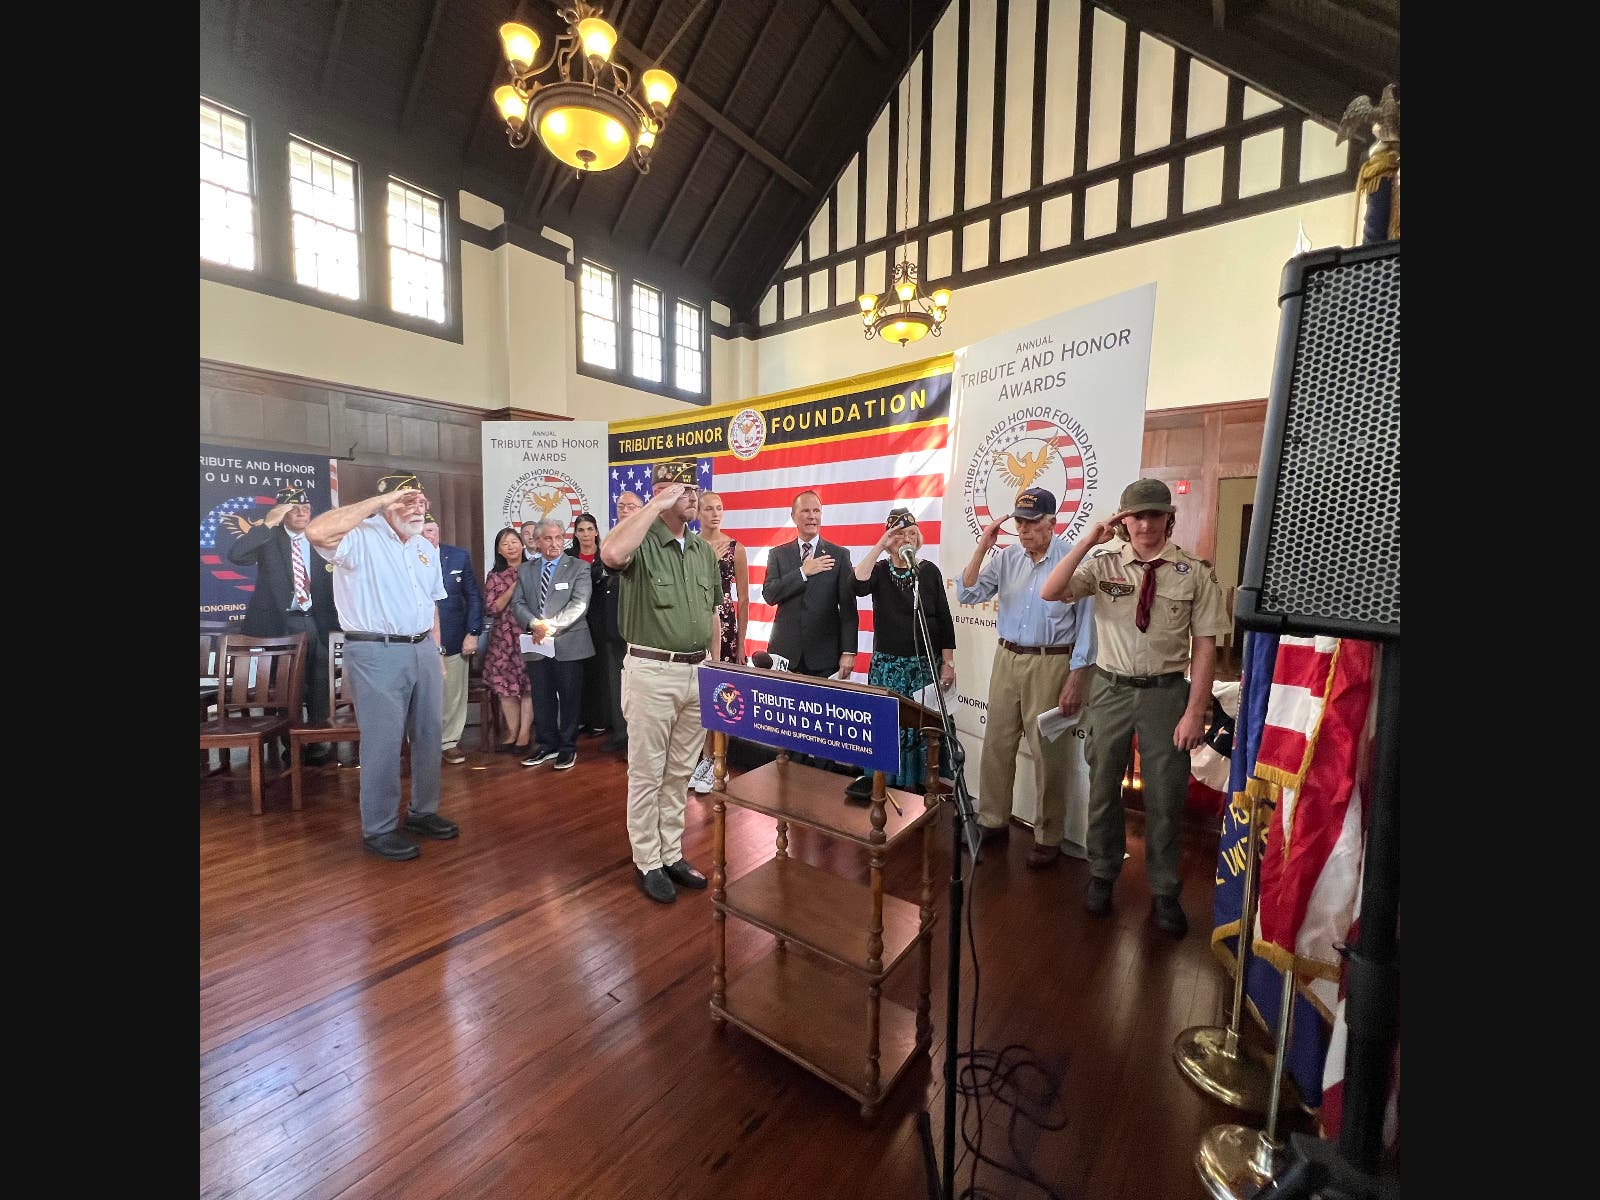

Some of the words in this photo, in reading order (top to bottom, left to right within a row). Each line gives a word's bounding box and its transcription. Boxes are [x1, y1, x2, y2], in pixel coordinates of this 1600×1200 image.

[961, 361, 1016, 390] TRIBUTE
[1021, 350, 1054, 373] AND
[1060, 328, 1131, 361] HONOR
[1016, 334, 1054, 354] ANNUAL
[998, 372, 1067, 401] AWARDS
[771, 389, 927, 434] FOUNDATION
[490, 438, 534, 449] TRIBUTE
[537, 440, 558, 449] AND
[562, 438, 600, 449] HONOR
[618, 435, 664, 453] TRIBUTE
[665, 434, 674, 449] &
[676, 427, 723, 447] HONOR
[963, 443, 987, 496] TRIBUTE
[985, 421, 1006, 444] AND
[1007, 406, 1051, 425] HONOR
[1052, 409, 1098, 490] FOUNDATION
[200, 456, 242, 469] RIBUTE
[246, 460, 271, 471] AND
[274, 461, 315, 475] HONOR
[522, 451, 567, 462] AWARDS
[205, 472, 316, 489] OUNDATION
[516, 472, 531, 487] AND
[530, 468, 560, 477] HONOR
[560, 472, 590, 514] FOUNDATIO
[751, 689, 796, 711] TRIBUTE
[798, 700, 823, 715] AND
[826, 702, 872, 725] HONOR
[753, 705, 872, 742] FOUNDATION
[753, 722, 780, 734] HONORING
[780, 728, 792, 737] AND
[792, 731, 827, 745] SUPPORTING
[827, 738, 841, 748] OUR
[841, 741, 873, 755] VETERANS
